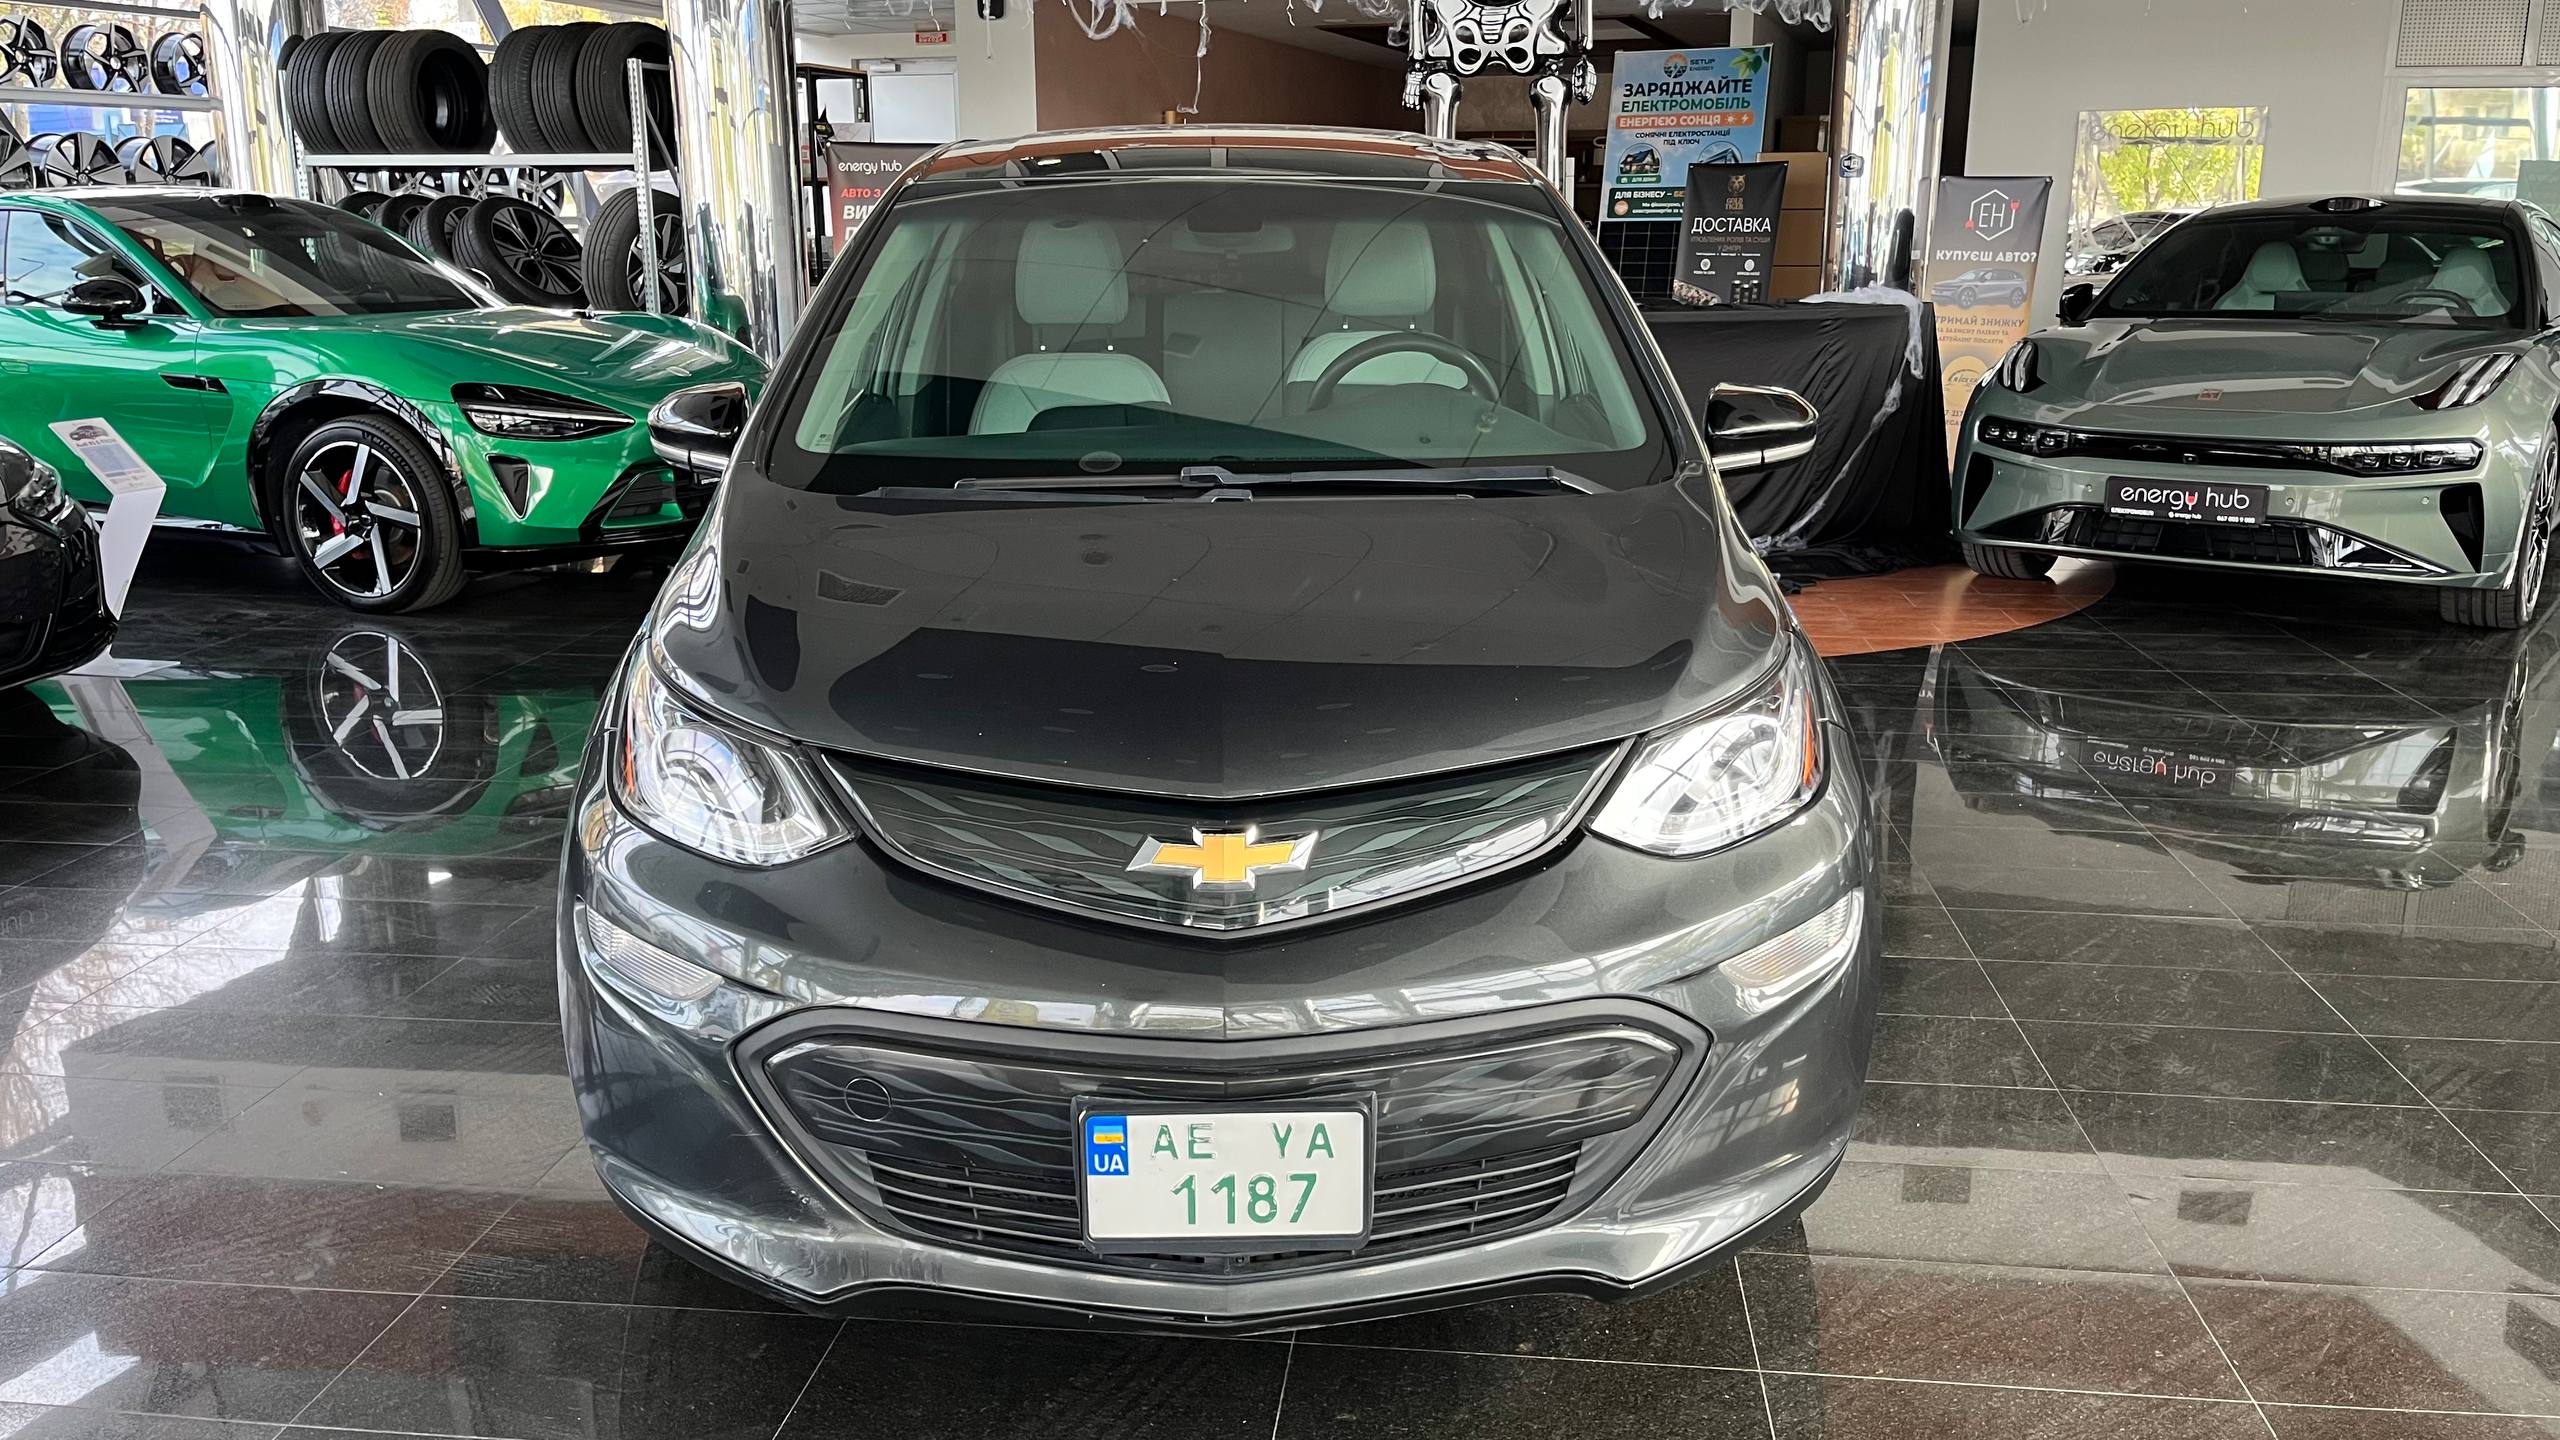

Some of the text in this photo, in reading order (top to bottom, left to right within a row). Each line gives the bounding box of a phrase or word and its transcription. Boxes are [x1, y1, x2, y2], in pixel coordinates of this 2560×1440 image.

[1623, 76, 1753, 98] ЗАРЯДЖАЙТЕ
[1621, 97, 1751, 113] ЕЛЕКТРОМОБІЛЬ
[1619, 114, 1721, 128] ЕНЕРГІЄЮ СОНЦЯ
[1668, 128, 1731, 138] ЕЛЕКТРОСТАНЦІЇ
[838, 160, 902, 175] energy hub
[841, 188, 871, 198] АВТО
[1614, 191, 1632, 199] ДЛЯ
[1632, 190, 1666, 199] БІЗНЕСУ
[1690, 217, 1772, 235] ДОСТАВКА
[1936, 249, 2038, 263] КУПУЄШ АВТО?
[1935, 315, 2025, 328] ТРИМАЙ ЗНИЖКУ
[2120, 486, 2198, 511] energy
[2205, 486, 2250, 510] hub
[1151, 1122, 1335, 1160] AE YA
[1093, 1154, 1125, 1173] UA
[1170, 1172, 1318, 1225] 1187
